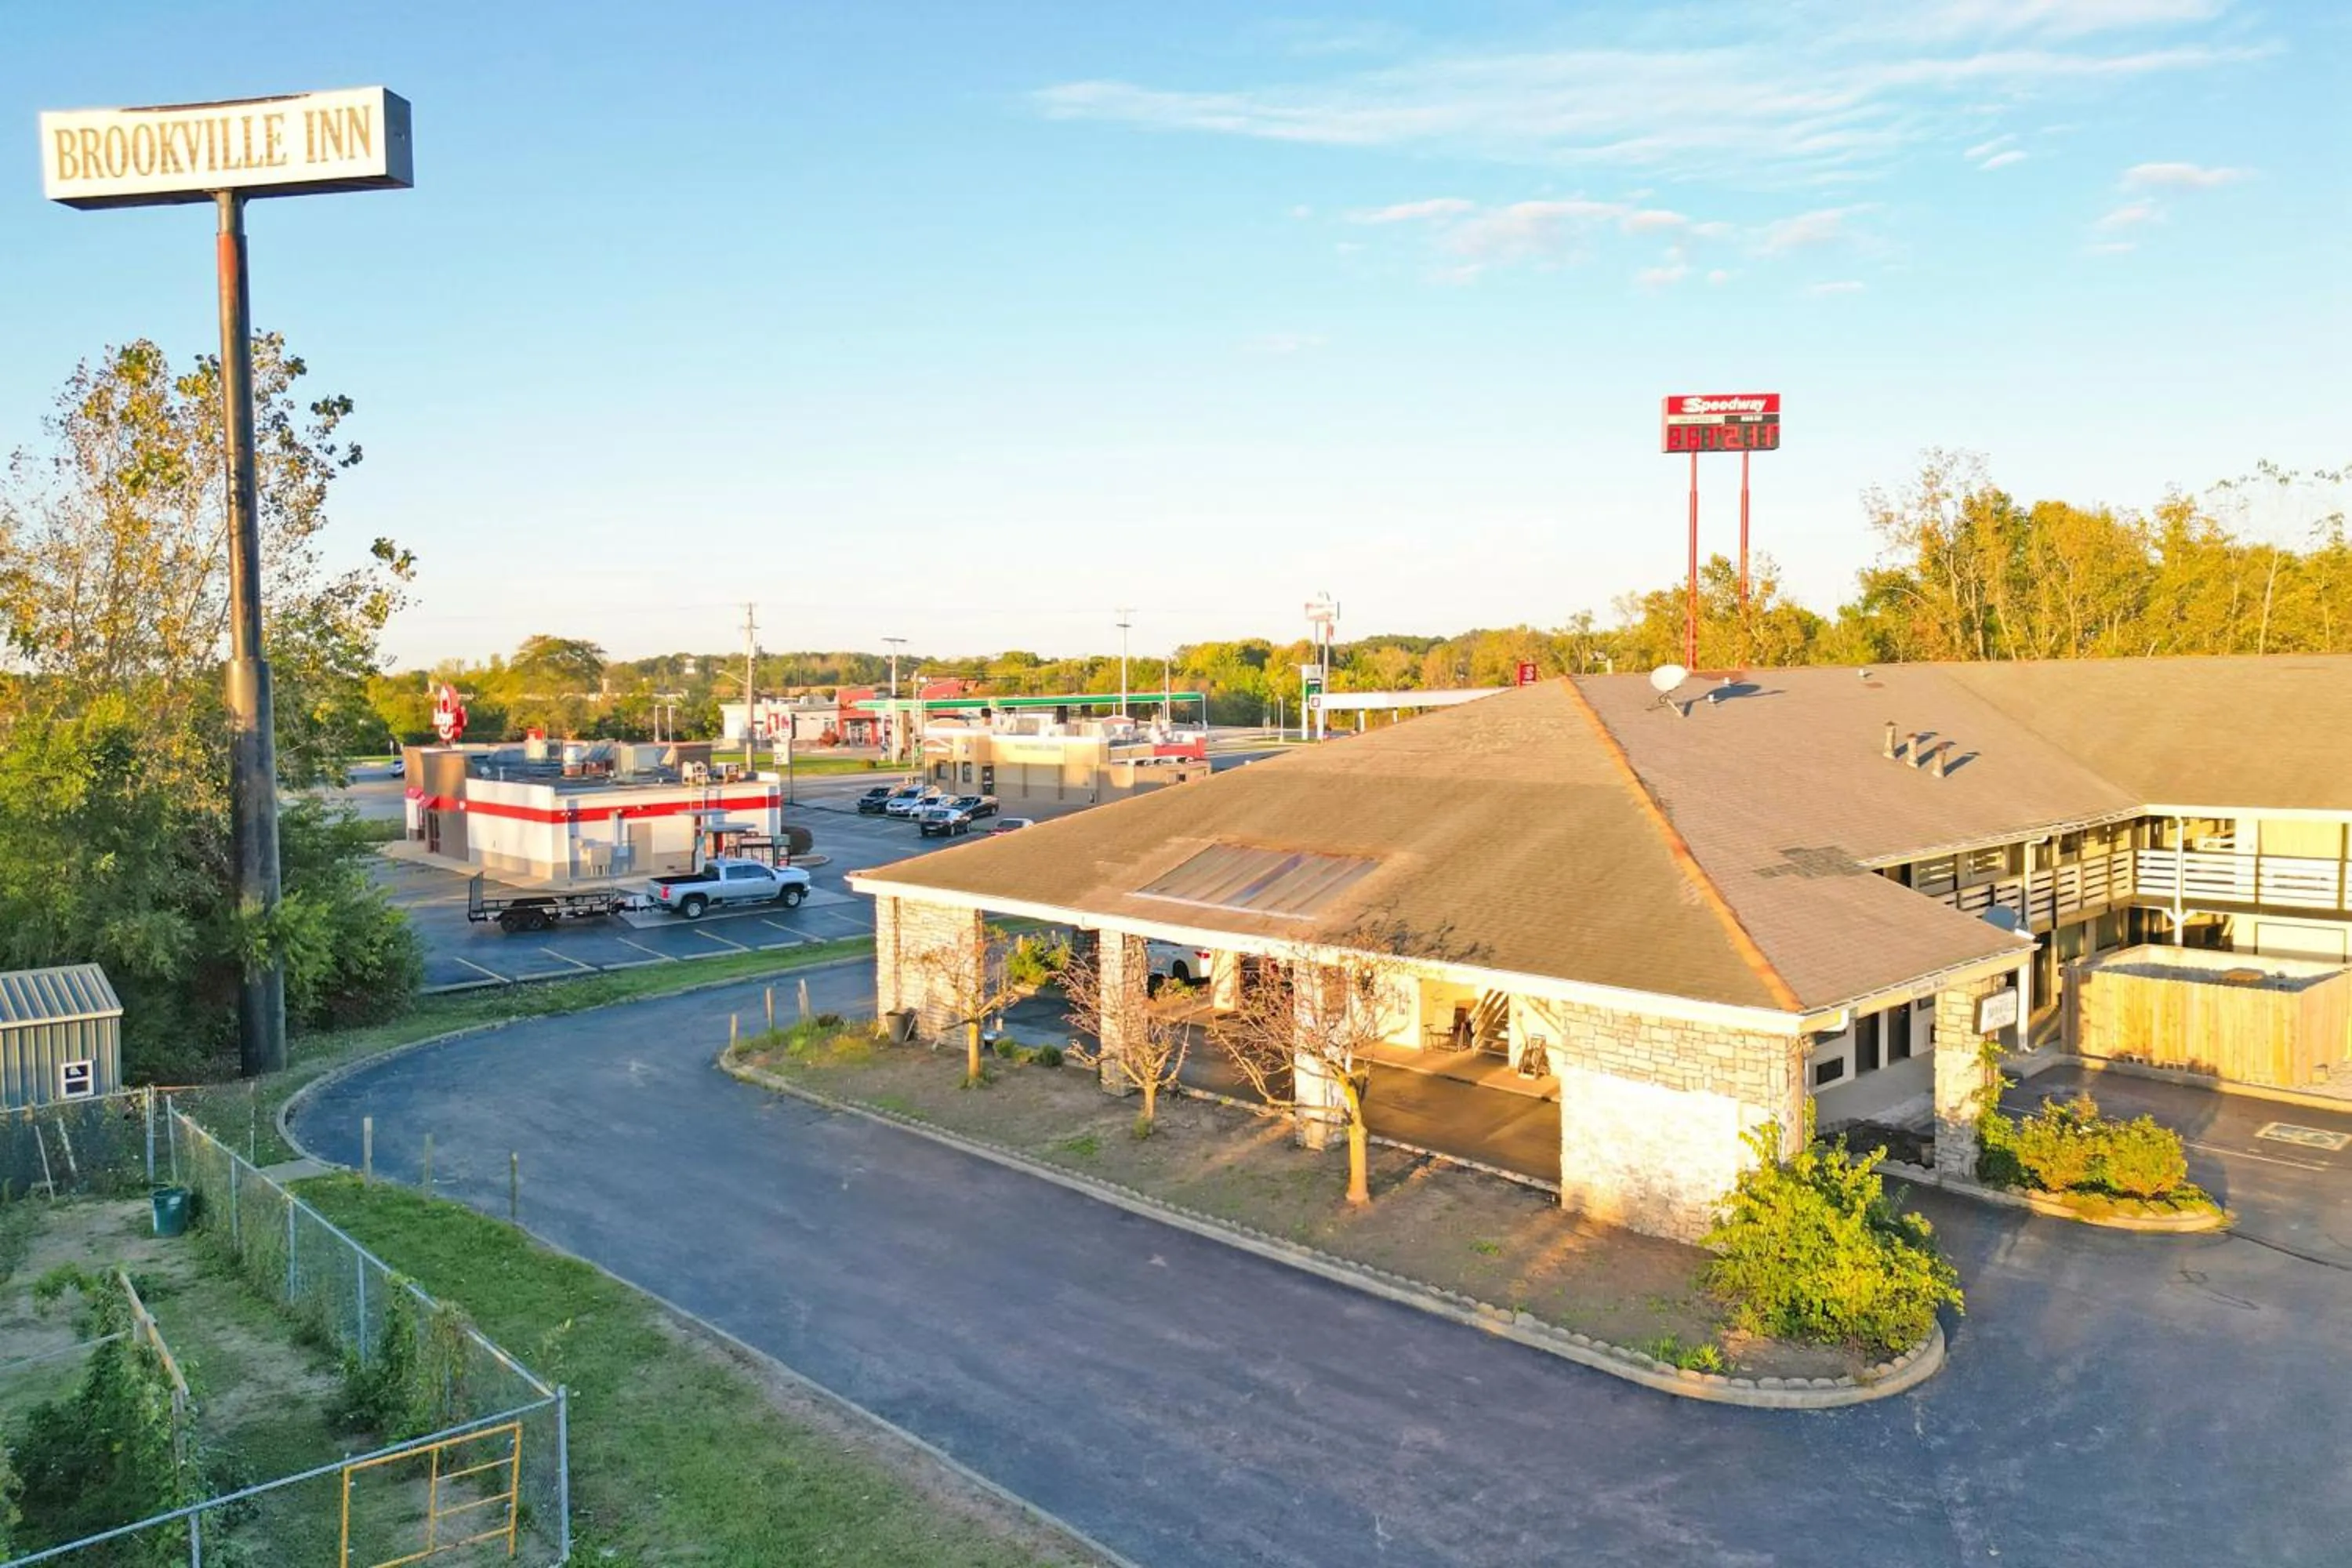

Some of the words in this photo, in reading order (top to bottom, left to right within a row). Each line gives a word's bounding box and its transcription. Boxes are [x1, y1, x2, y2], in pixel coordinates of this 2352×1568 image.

[54, 113, 287, 181] BROOKVILLE
[304, 105, 373, 165] INN
[1681, 397, 1767, 414] Speedway
